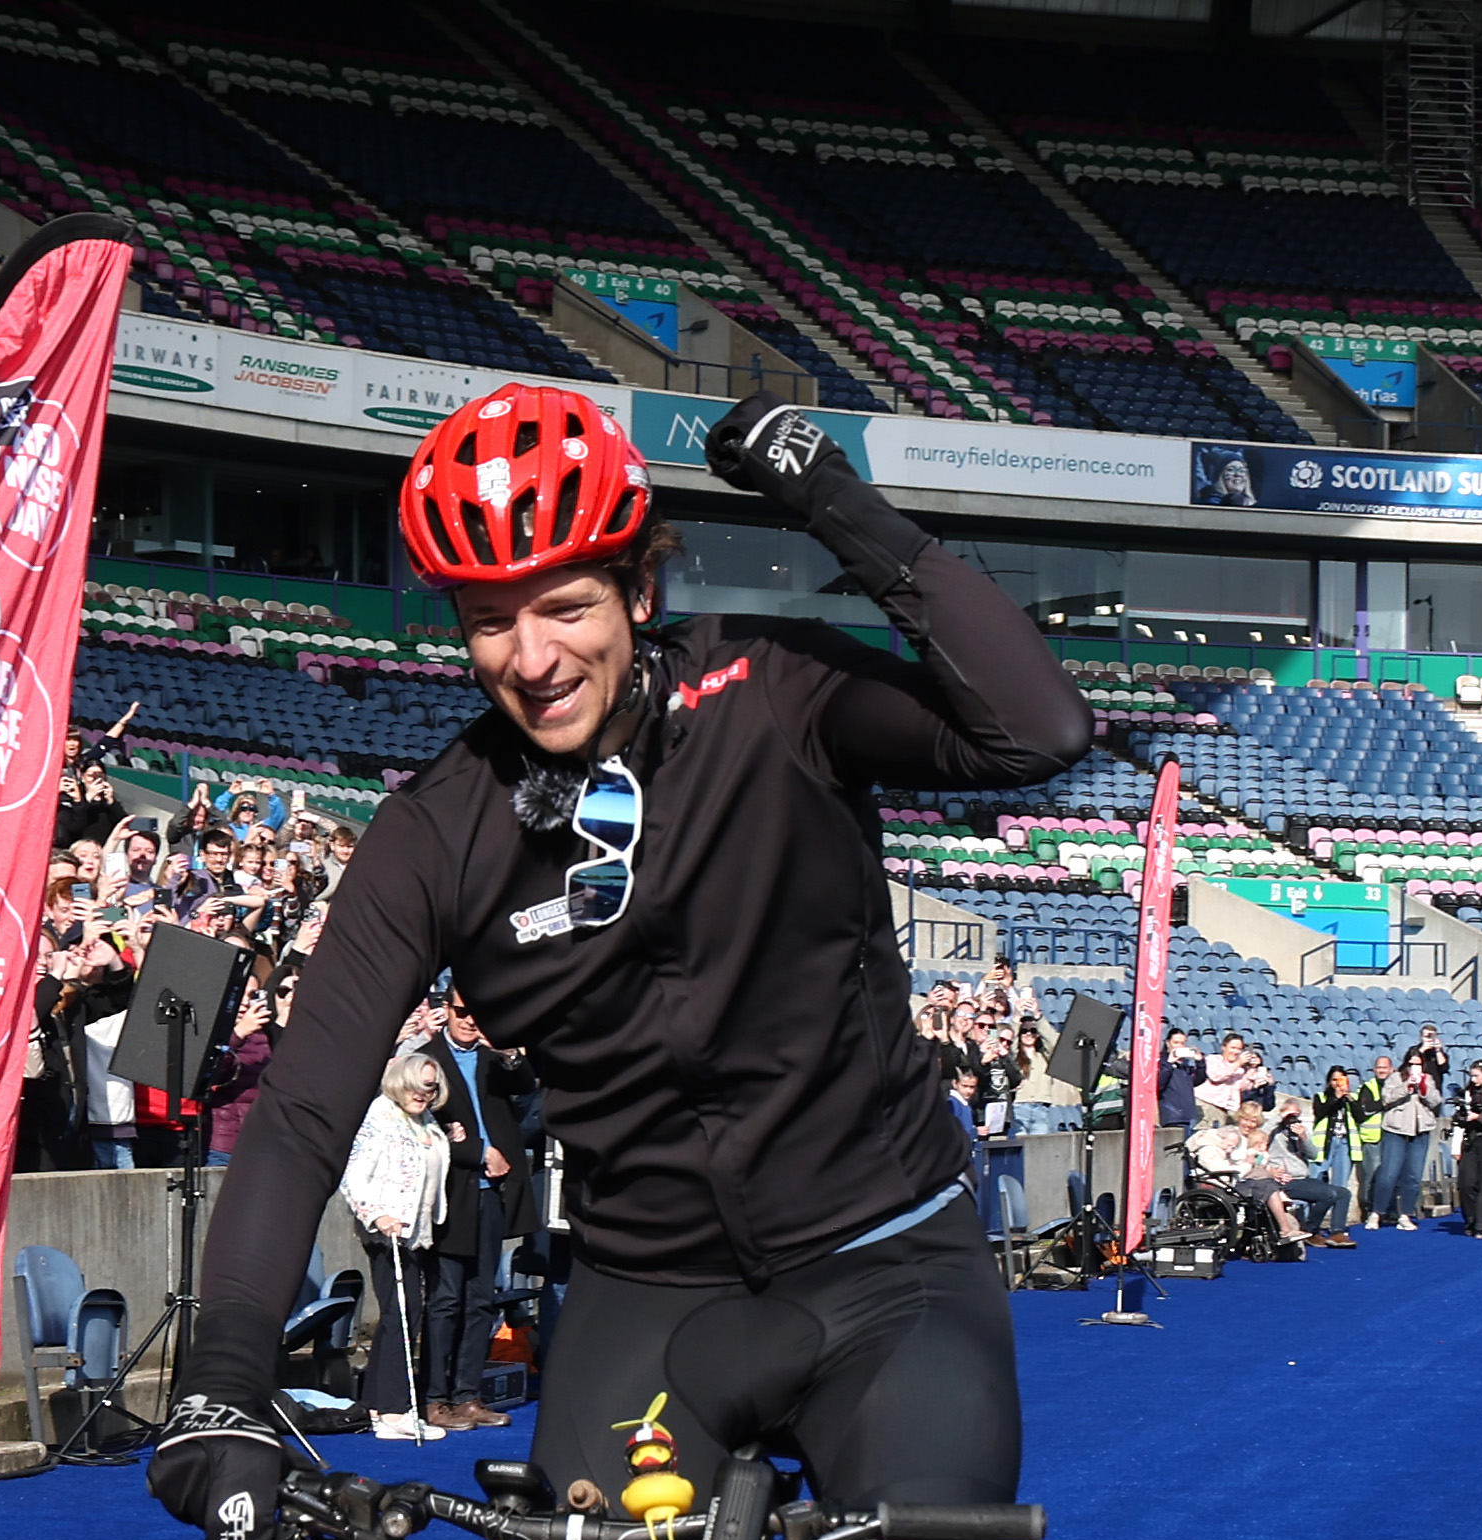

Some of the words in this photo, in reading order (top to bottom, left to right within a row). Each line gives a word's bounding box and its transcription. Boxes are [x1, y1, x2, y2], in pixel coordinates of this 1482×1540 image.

[570, 273, 587, 286] 40
[611, 276, 630, 288] Exit
[654, 284, 671, 296] 40
[122, 343, 214, 372] IRWAYS
[1308, 339, 1325, 351] 42
[1349, 340, 1368, 350] Exit
[1393, 344, 1409, 356] 42
[239, 355, 340, 381] RANSOMES
[1371, 389, 1398, 403] Gas
[13, 423, 60, 467] RED
[904, 443, 1154, 479] murrayfieldexperience.com
[1330, 464, 1452, 493] SCOTLAND
[7, 492, 53, 545] DAY
[1317, 501, 1342, 512] JOIN
[1342, 503, 1367, 514] NOW
[1367, 504, 1387, 515] FOR
[1387, 504, 1439, 517] EXCLUSIVE
[1440, 508, 1463, 519] NEW
[1286, 887, 1308, 899] Exit
[1365, 887, 1381, 901] 33
[487, 1464, 523, 1474] GARMIN
